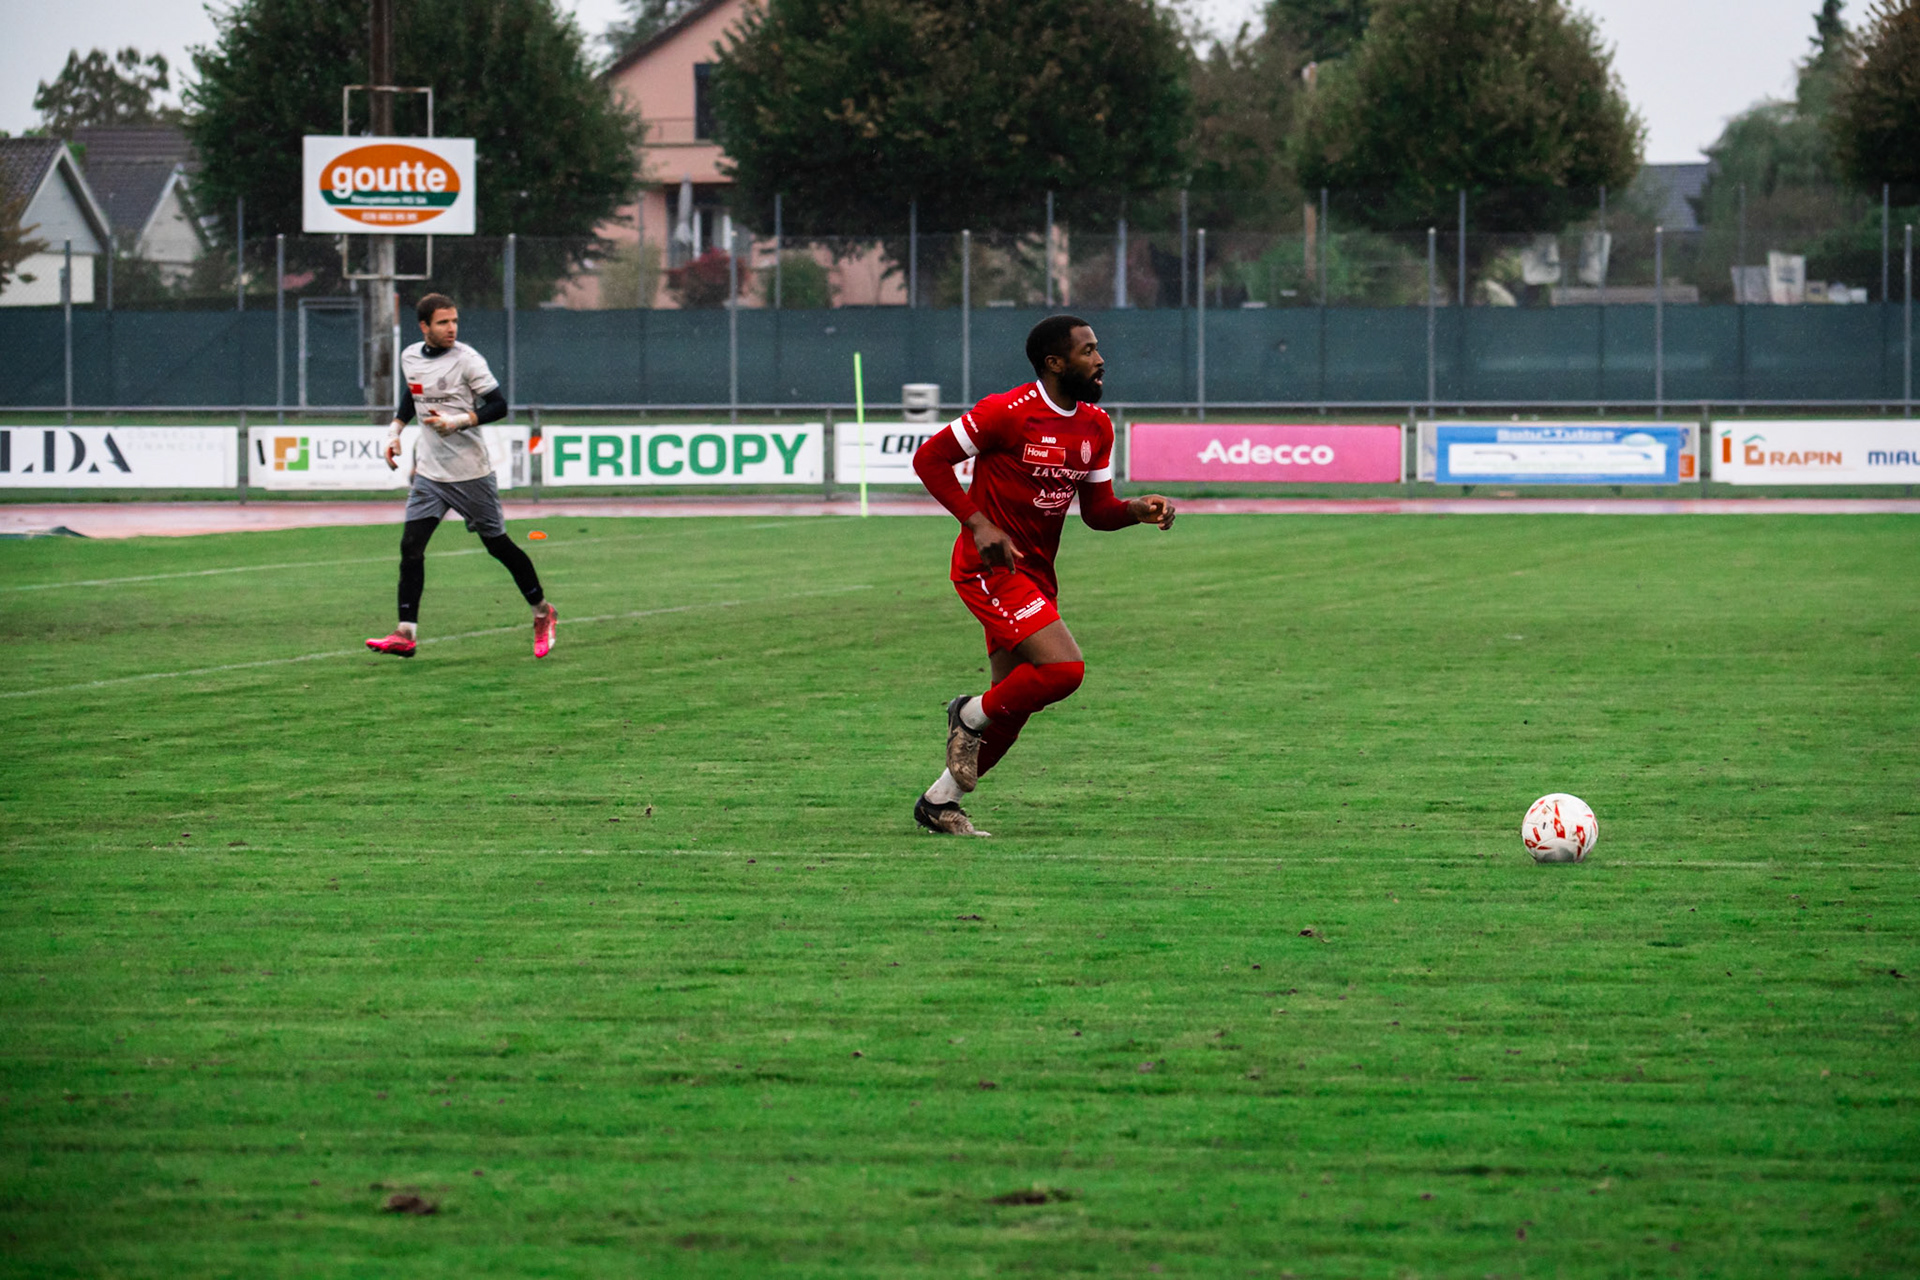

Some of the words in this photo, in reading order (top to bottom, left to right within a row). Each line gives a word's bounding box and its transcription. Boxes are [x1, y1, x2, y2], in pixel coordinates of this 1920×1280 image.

[331, 161, 447, 199] goutte
[553, 433, 808, 476] FRICOPY
[1027, 447, 1049, 458] Hoval
[1197, 438, 1334, 465] Adecco
